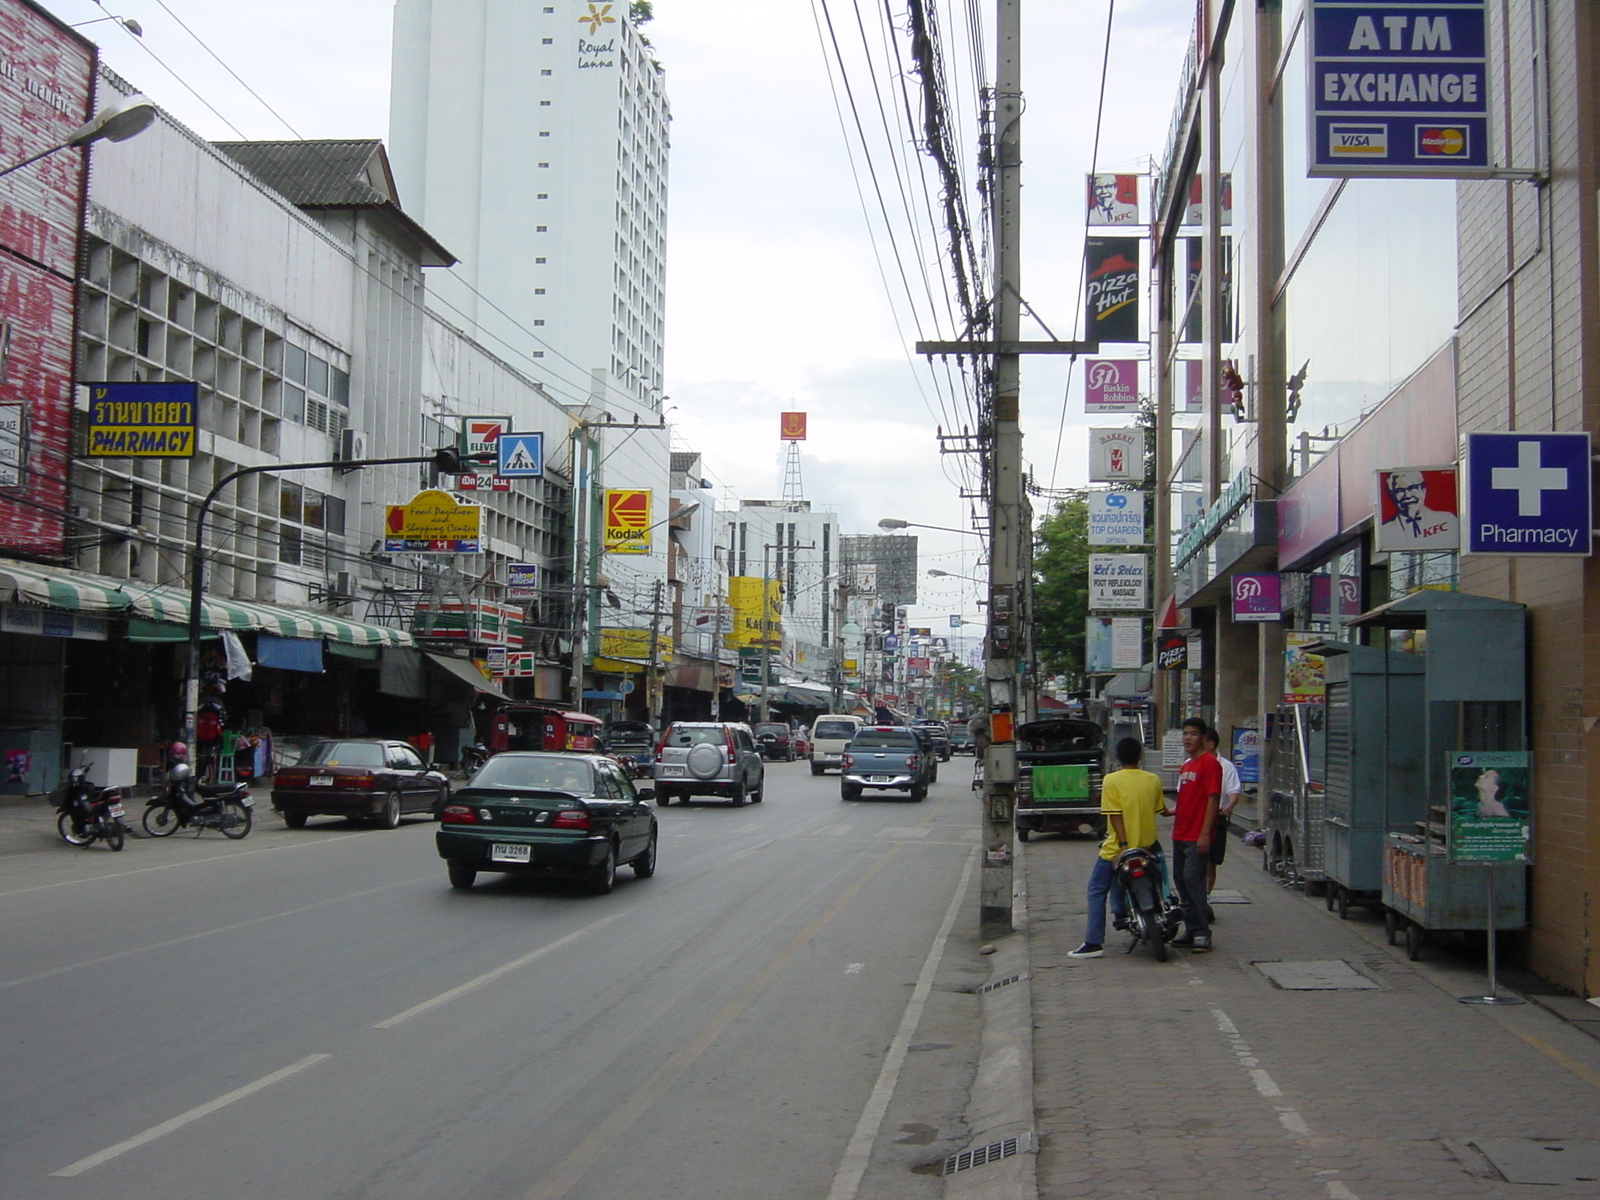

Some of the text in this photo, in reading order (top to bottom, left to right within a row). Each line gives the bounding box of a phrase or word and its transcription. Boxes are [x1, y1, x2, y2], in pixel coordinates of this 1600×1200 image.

[1348, 15, 1452, 51] ATM
[578, 38, 615, 57] Royal
[578, 56, 613, 68] Lanna
[1324, 73, 1477, 103] EXCHANGE
[1341, 135, 1370, 146] VISA
[1422, 137, 1463, 146] MasterCard
[1114, 211, 1132, 223] KFC
[1087, 272, 1138, 306] Pizza
[1096, 287, 1134, 312] Hut
[1088, 368, 1114, 390] 31
[1103, 384, 1129, 393] Baskin
[1103, 393, 1135, 402] Robbins
[95, 388, 191, 424] ร้านขายยา
[471, 424, 502, 442] 7
[92, 430, 190, 453] PHARMACY
[470, 443, 498, 451] ELEVE
[477, 476, 492, 488] 24
[607, 529, 646, 540] Kodak
[1091, 526, 1105, 534] TOP
[1423, 522, 1448, 538] KFC
[1481, 524, 1578, 547] Pharmacy
[1093, 563, 1143, 575] Let's Relax
[1093, 579, 1142, 587] FOOT REFLEXOLOGY
[1236, 583, 1257, 601] 31
[1159, 647, 1186, 664] Pizza
[1164, 654, 1184, 667] Hut
[509, 847, 528, 855] 3268
